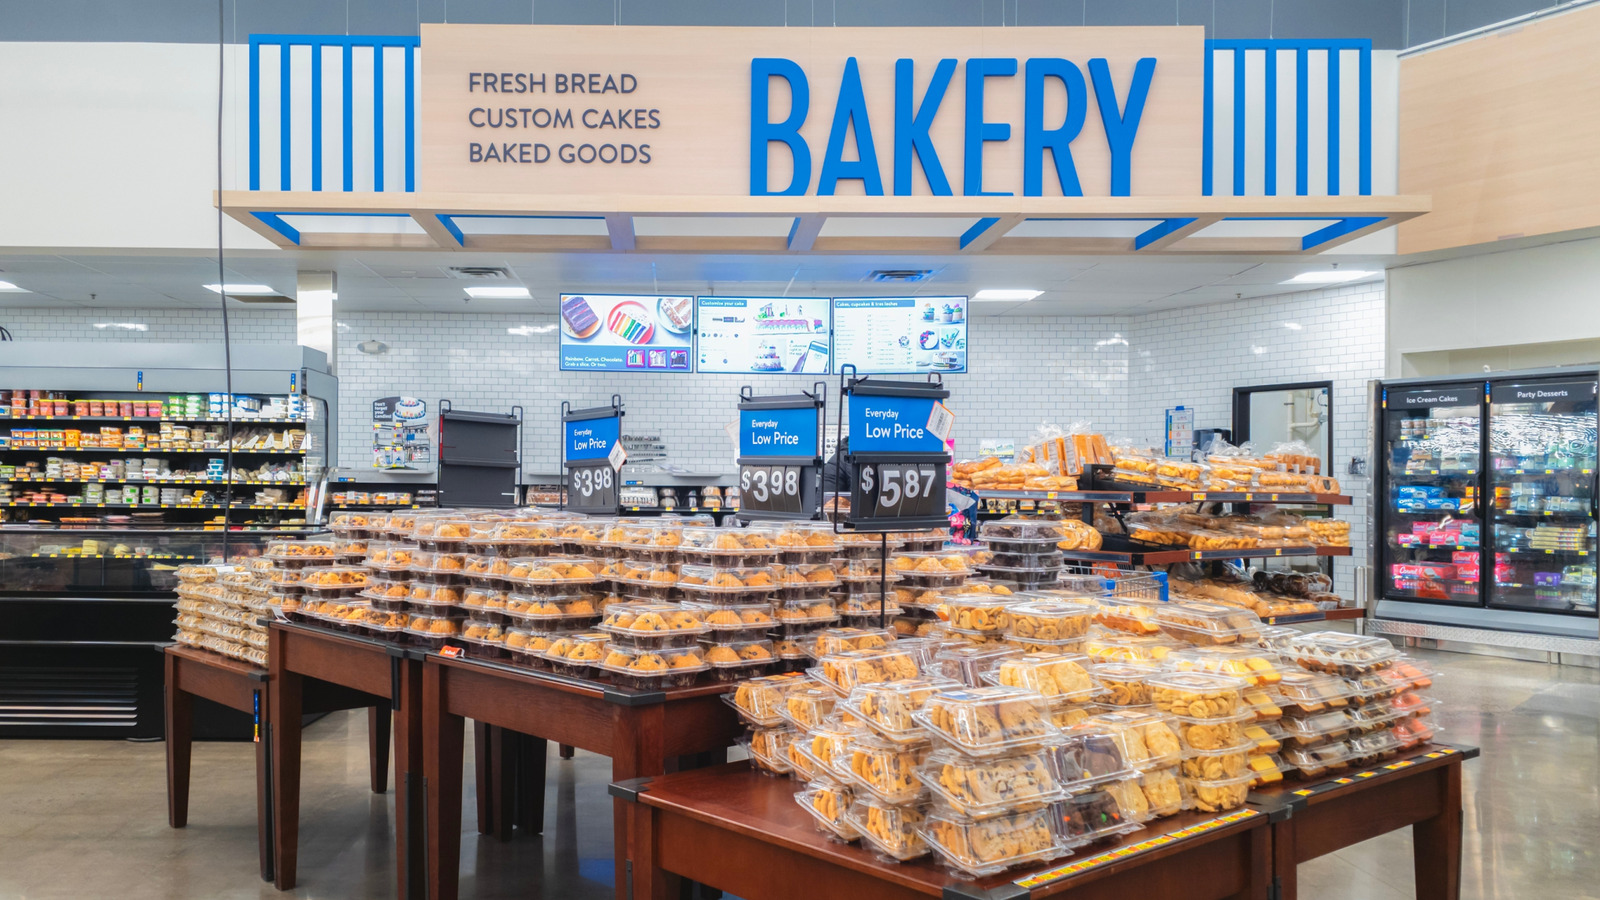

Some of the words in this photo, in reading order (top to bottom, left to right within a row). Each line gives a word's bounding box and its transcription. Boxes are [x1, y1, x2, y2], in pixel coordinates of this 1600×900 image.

[470, 72, 546, 93] FRESH
[555, 73, 638, 94] BREAD
[468, 108, 574, 128] CUSTOM
[582, 108, 660, 129] CAKES
[750, 56, 1157, 197] BAKERY
[470, 142, 550, 163] BAKED
[558, 144, 652, 164] GOODS
[1517, 391, 1536, 399] Party
[1538, 389, 1568, 397] Desserts
[865, 408, 899, 420] Everyday
[752, 419, 778, 429] Everyday
[574, 428, 592, 437] Everyday
[866, 423, 891, 438] Low
[894, 423, 924, 439] Price
[574, 440, 588, 450] Low
[589, 438, 606, 449] Price
[752, 432, 771, 444] Low
[774, 432, 799, 445] Price
